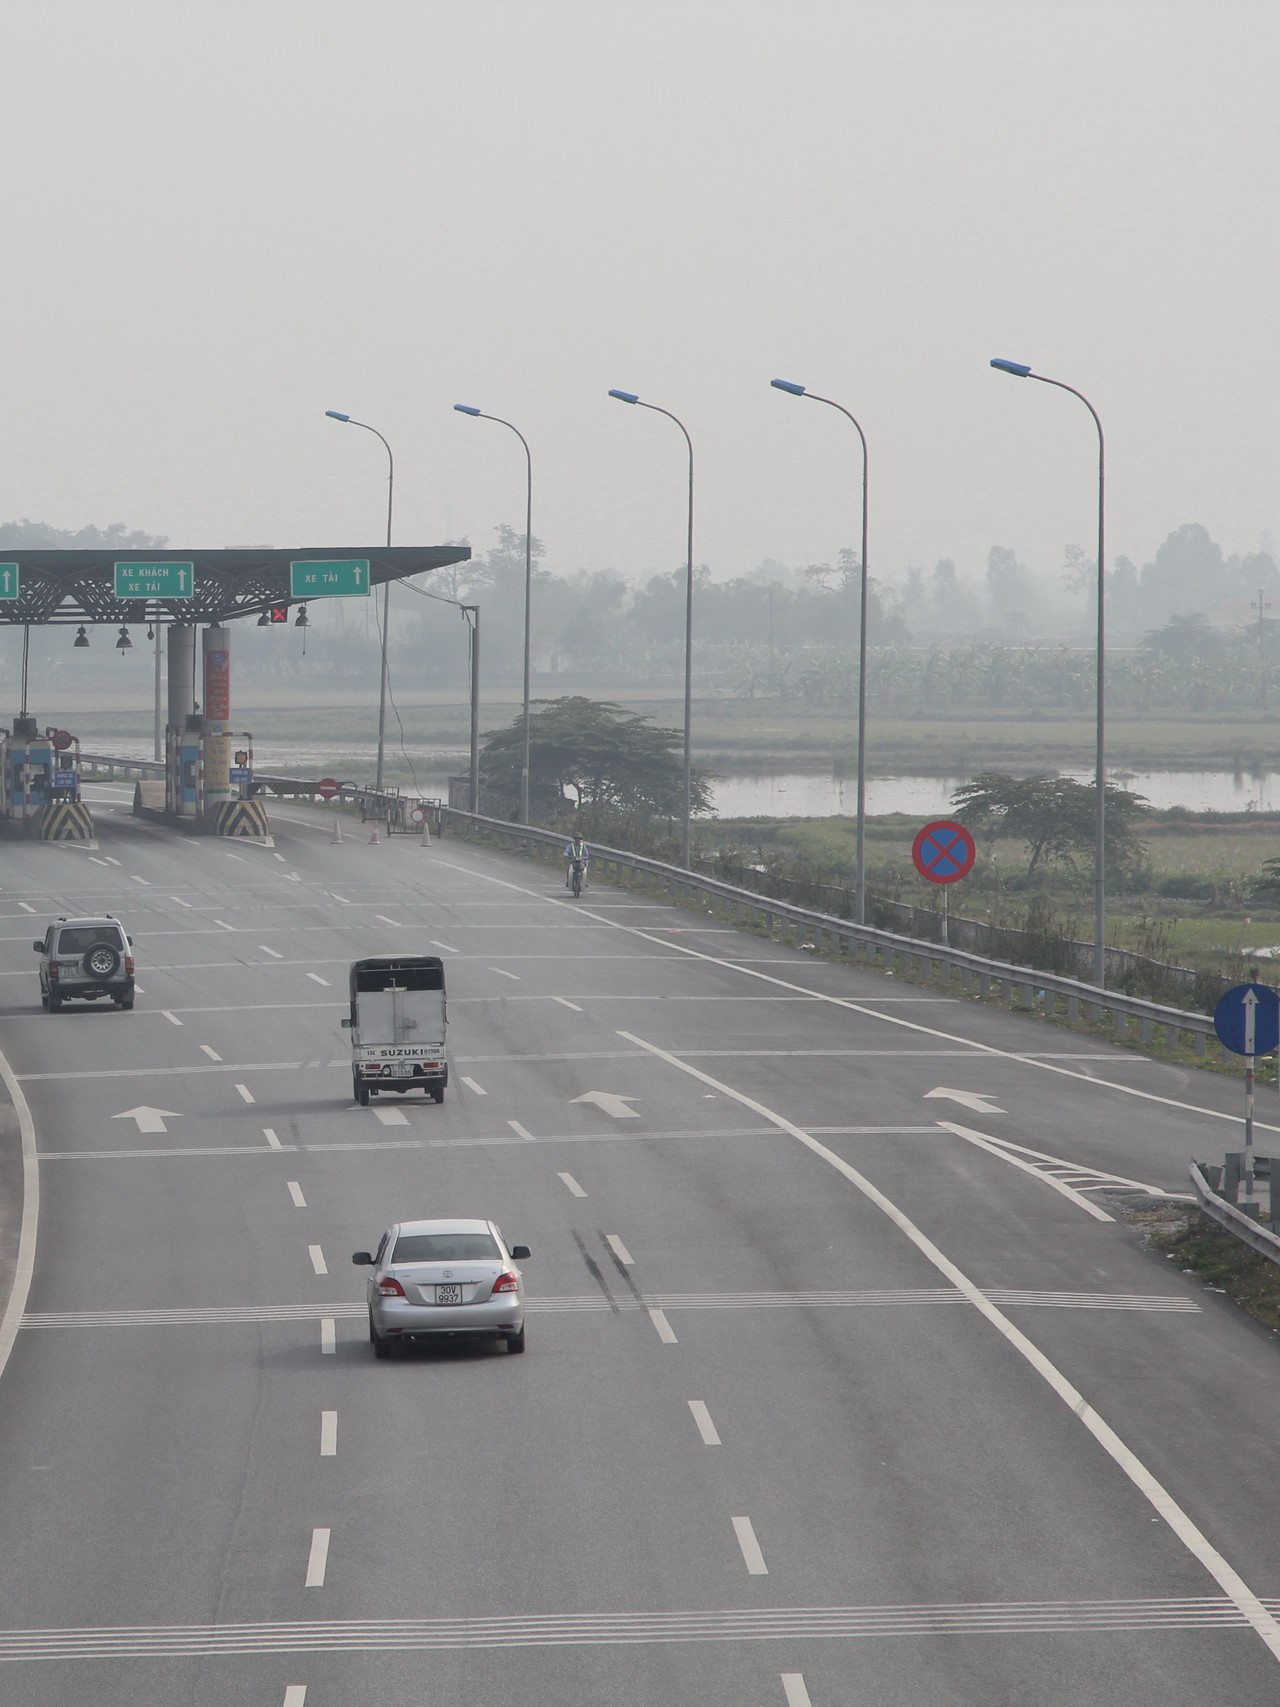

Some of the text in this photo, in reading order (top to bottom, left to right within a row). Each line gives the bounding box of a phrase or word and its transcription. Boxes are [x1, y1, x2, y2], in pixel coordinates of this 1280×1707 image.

[122, 566, 169, 577] XE KHÁCH
[305, 574, 317, 583] XE
[128, 583, 140, 591] XE
[380, 1048, 424, 1057] SUZUKI
[440, 1286, 456, 1294] 30V
[438, 1294, 459, 1303] 9937
